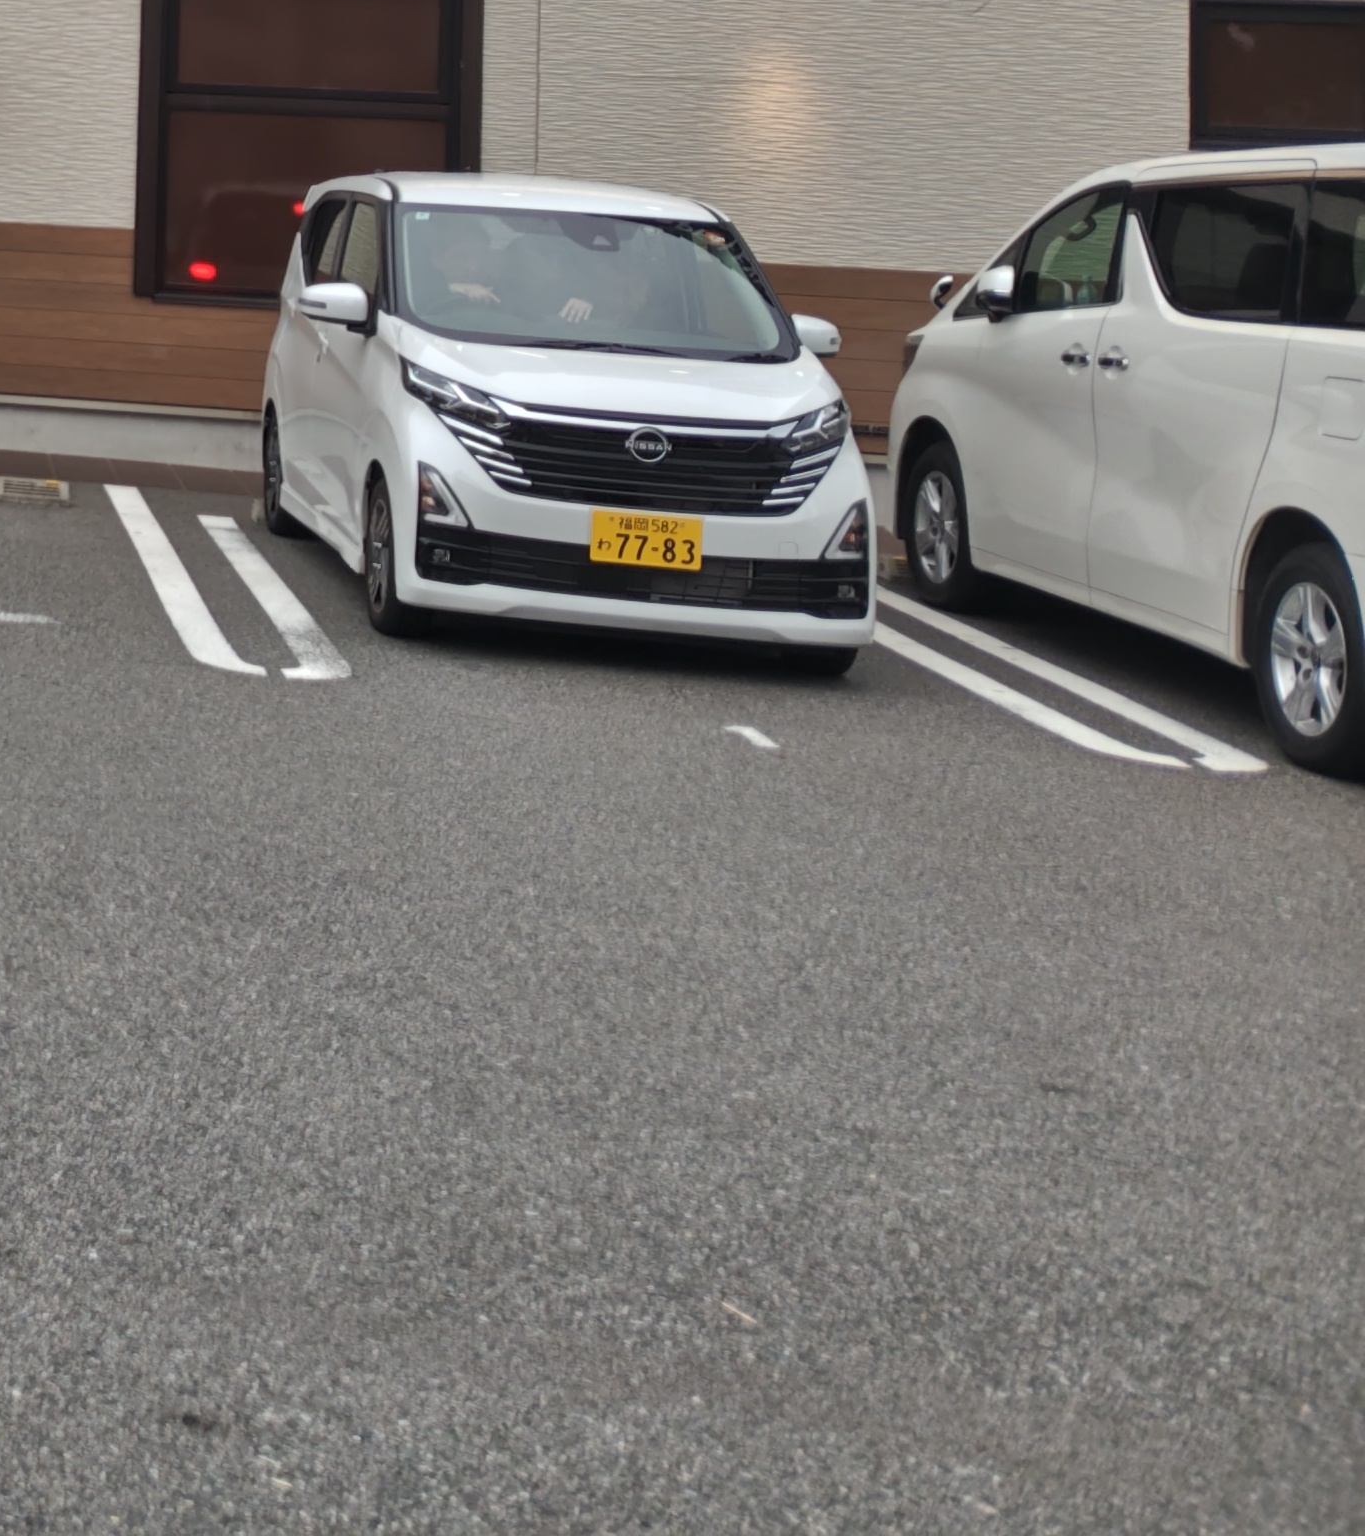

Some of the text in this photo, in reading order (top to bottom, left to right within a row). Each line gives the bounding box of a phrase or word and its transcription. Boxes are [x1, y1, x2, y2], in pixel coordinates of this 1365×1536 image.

[625, 439, 673, 451] NISSAN
[618, 516, 679, 535] 福岡 582
[597, 532, 696, 565] わ 77-83
